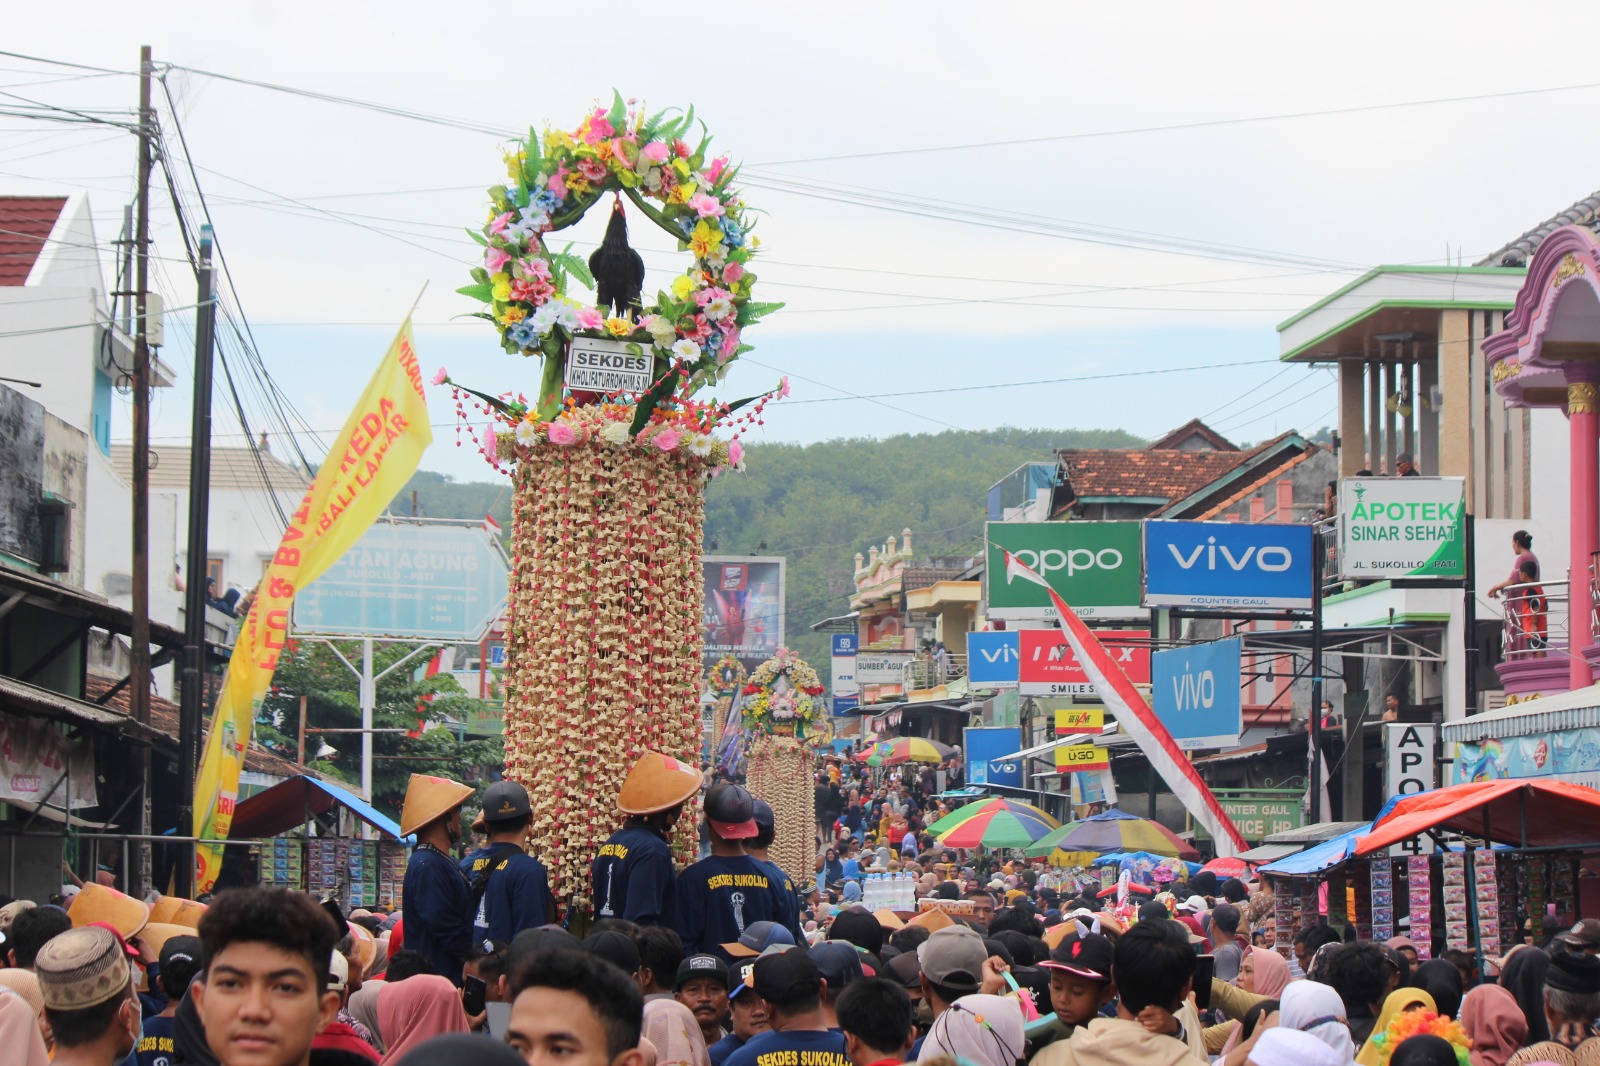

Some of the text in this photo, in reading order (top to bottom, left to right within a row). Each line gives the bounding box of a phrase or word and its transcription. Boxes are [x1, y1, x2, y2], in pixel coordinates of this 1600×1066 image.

[576, 352, 646, 371] SEKDES
[1350, 502, 1456, 521] APOTEK
[1351, 525, 1457, 541] SINAR SEHAT
[397, 551, 479, 571] AGUNG
[1167, 535, 1292, 572] vivo
[1353, 561, 1368, 569] JL.
[1371, 560, 1425, 569] SUKOLILO
[1190, 597, 1240, 605] COUNTER
[858, 662, 885, 671] SUMBER
[1051, 684, 1085, 693] SMILE
[1173, 660, 1215, 711] vivo
[1261, 805, 1290, 815] GAUL
[707, 874, 733, 890] SEKDES
[734, 874, 769, 889] SUKOLILO
[757, 1050, 798, 1066] SEKDES
